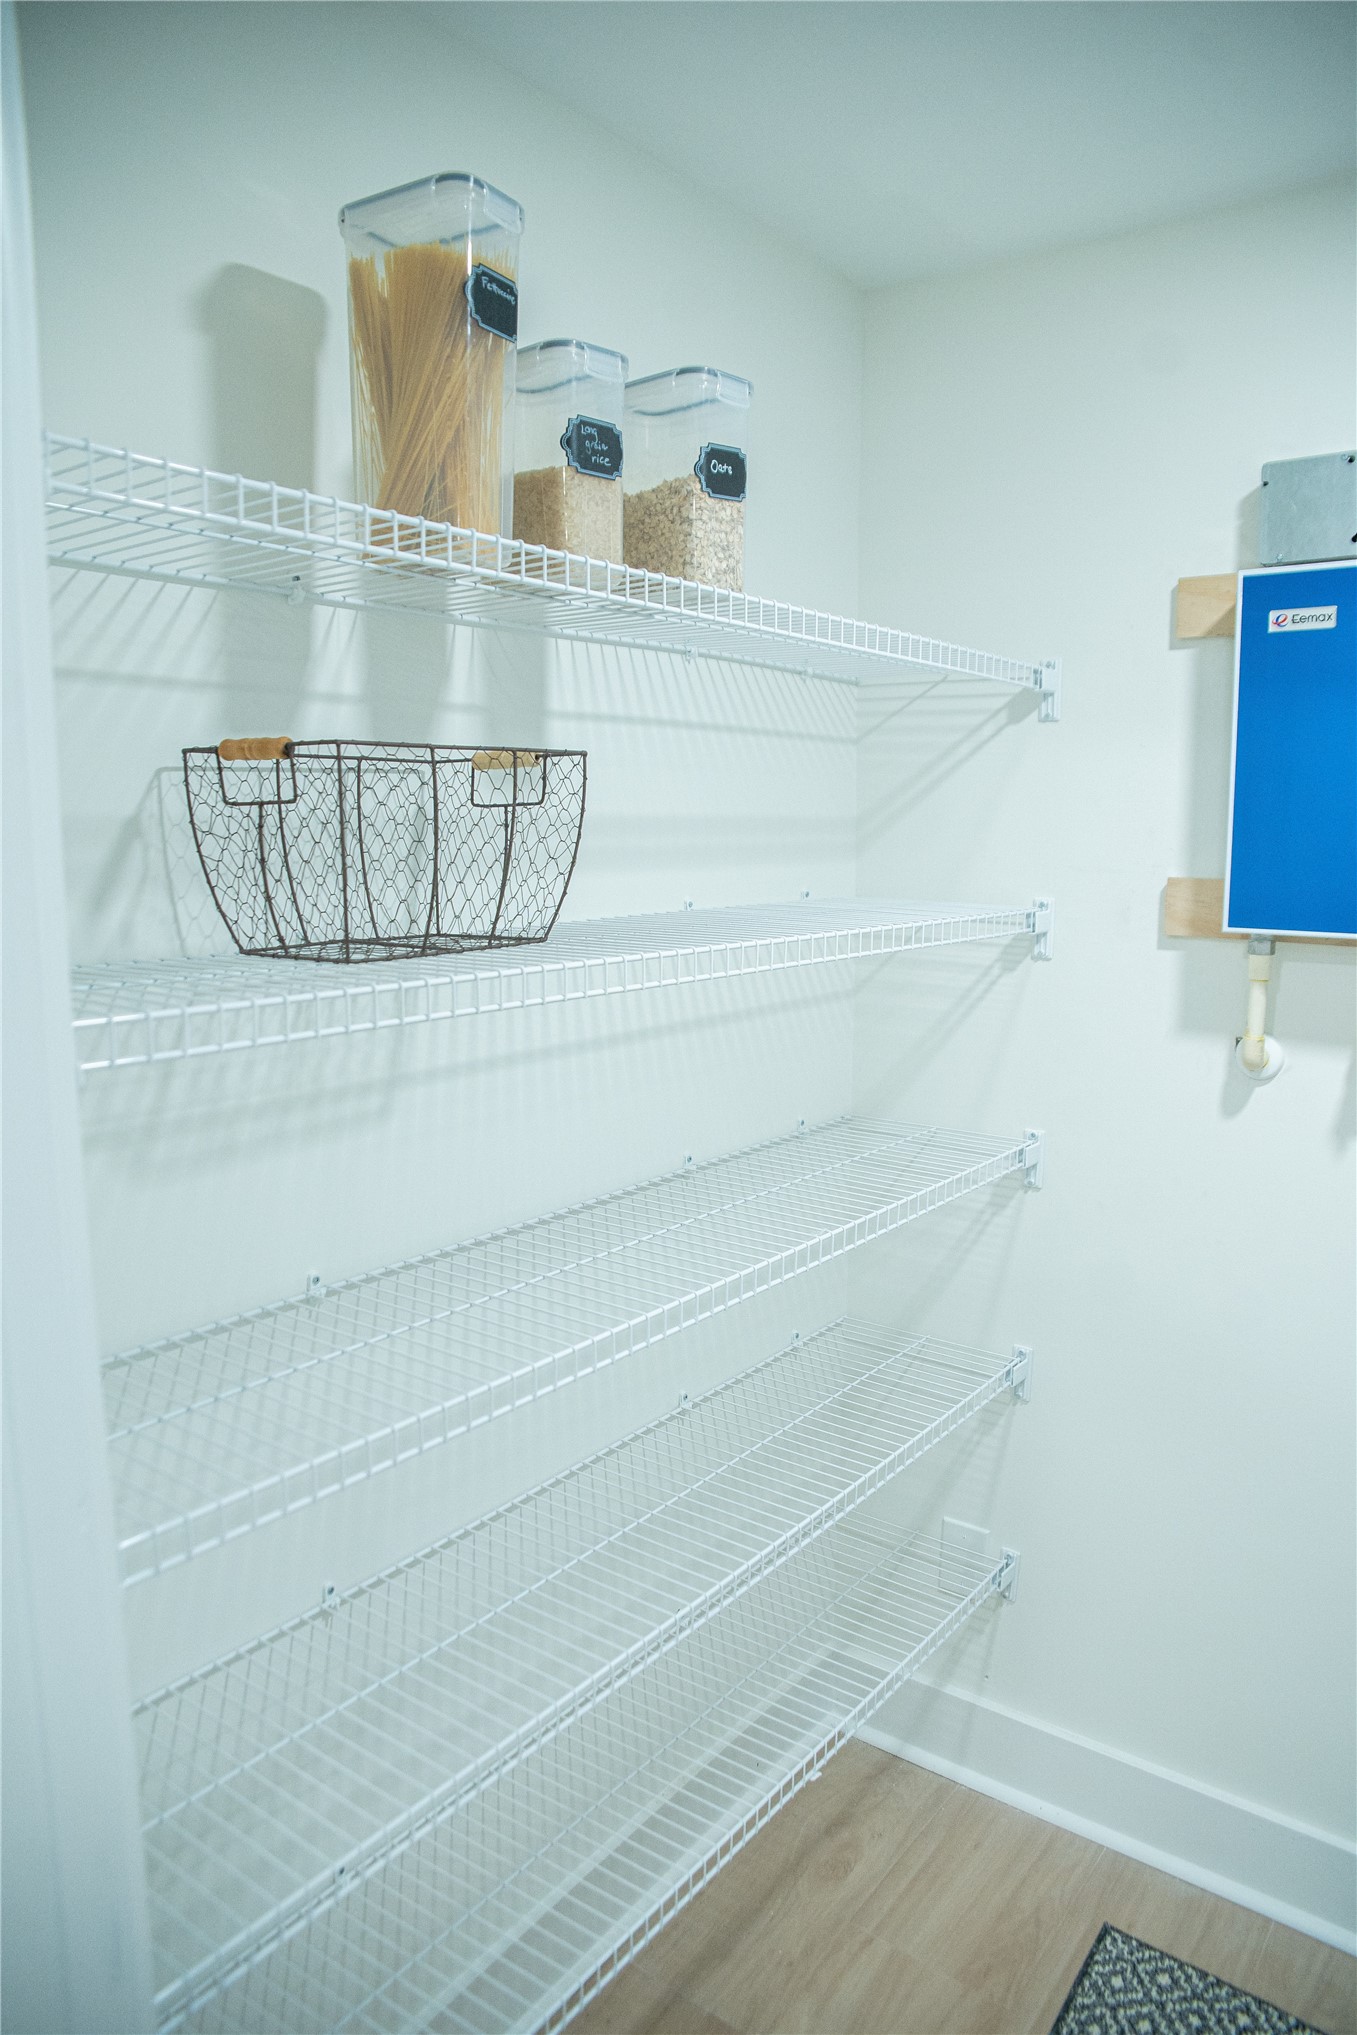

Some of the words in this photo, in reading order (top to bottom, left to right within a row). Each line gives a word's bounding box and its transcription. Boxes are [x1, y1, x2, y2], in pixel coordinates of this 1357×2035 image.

[581, 424, 598, 443] Long
[585, 440, 608, 455] grain
[591, 453, 611, 466] rice
[710, 459, 733, 475] Oats
[1291, 612, 1334, 624] Eemax
